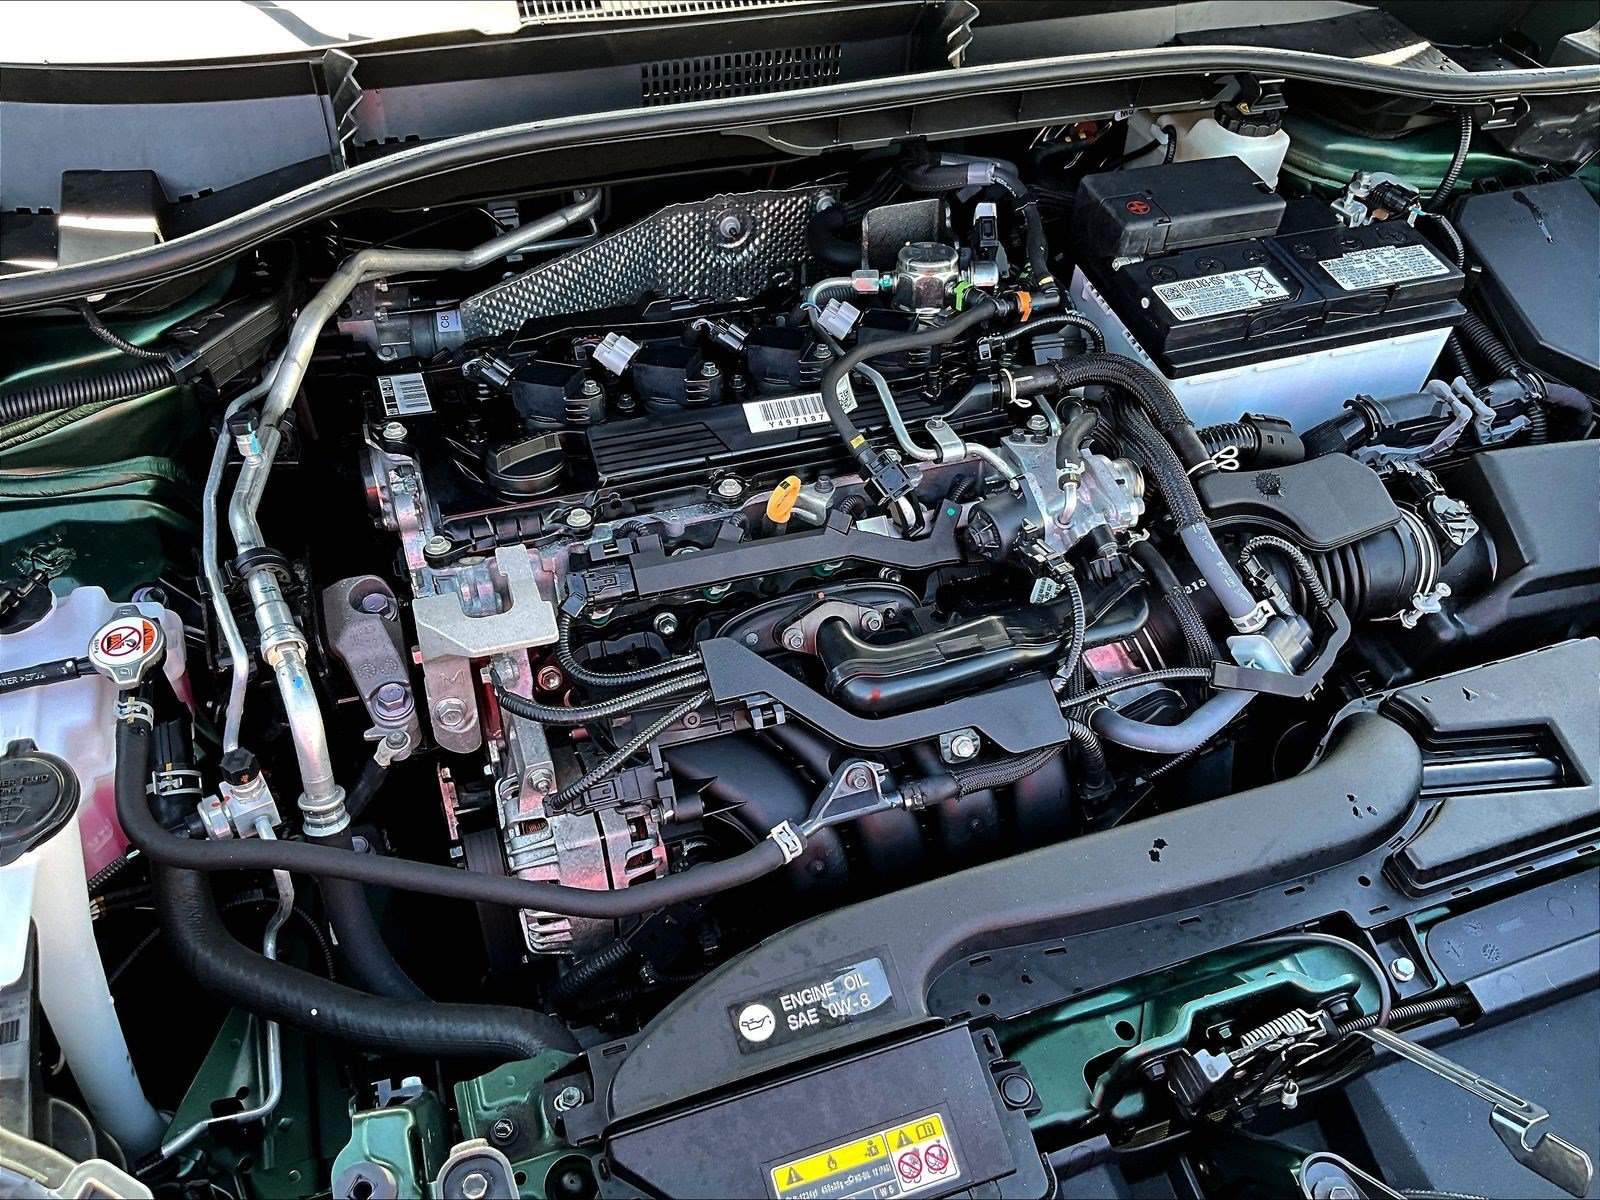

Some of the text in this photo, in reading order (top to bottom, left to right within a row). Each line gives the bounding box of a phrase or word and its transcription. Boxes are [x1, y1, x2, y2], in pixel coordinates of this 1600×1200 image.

[1178, 276, 1226, 292] 380LN3-ISS
[1175, 306, 1194, 317] TM
[440, 315, 450, 328] C8
[21, 774, 49, 785] FLUID
[779, 973, 869, 1012] ENGINE OIL
[787, 992, 871, 1031] SAE 0W-8
